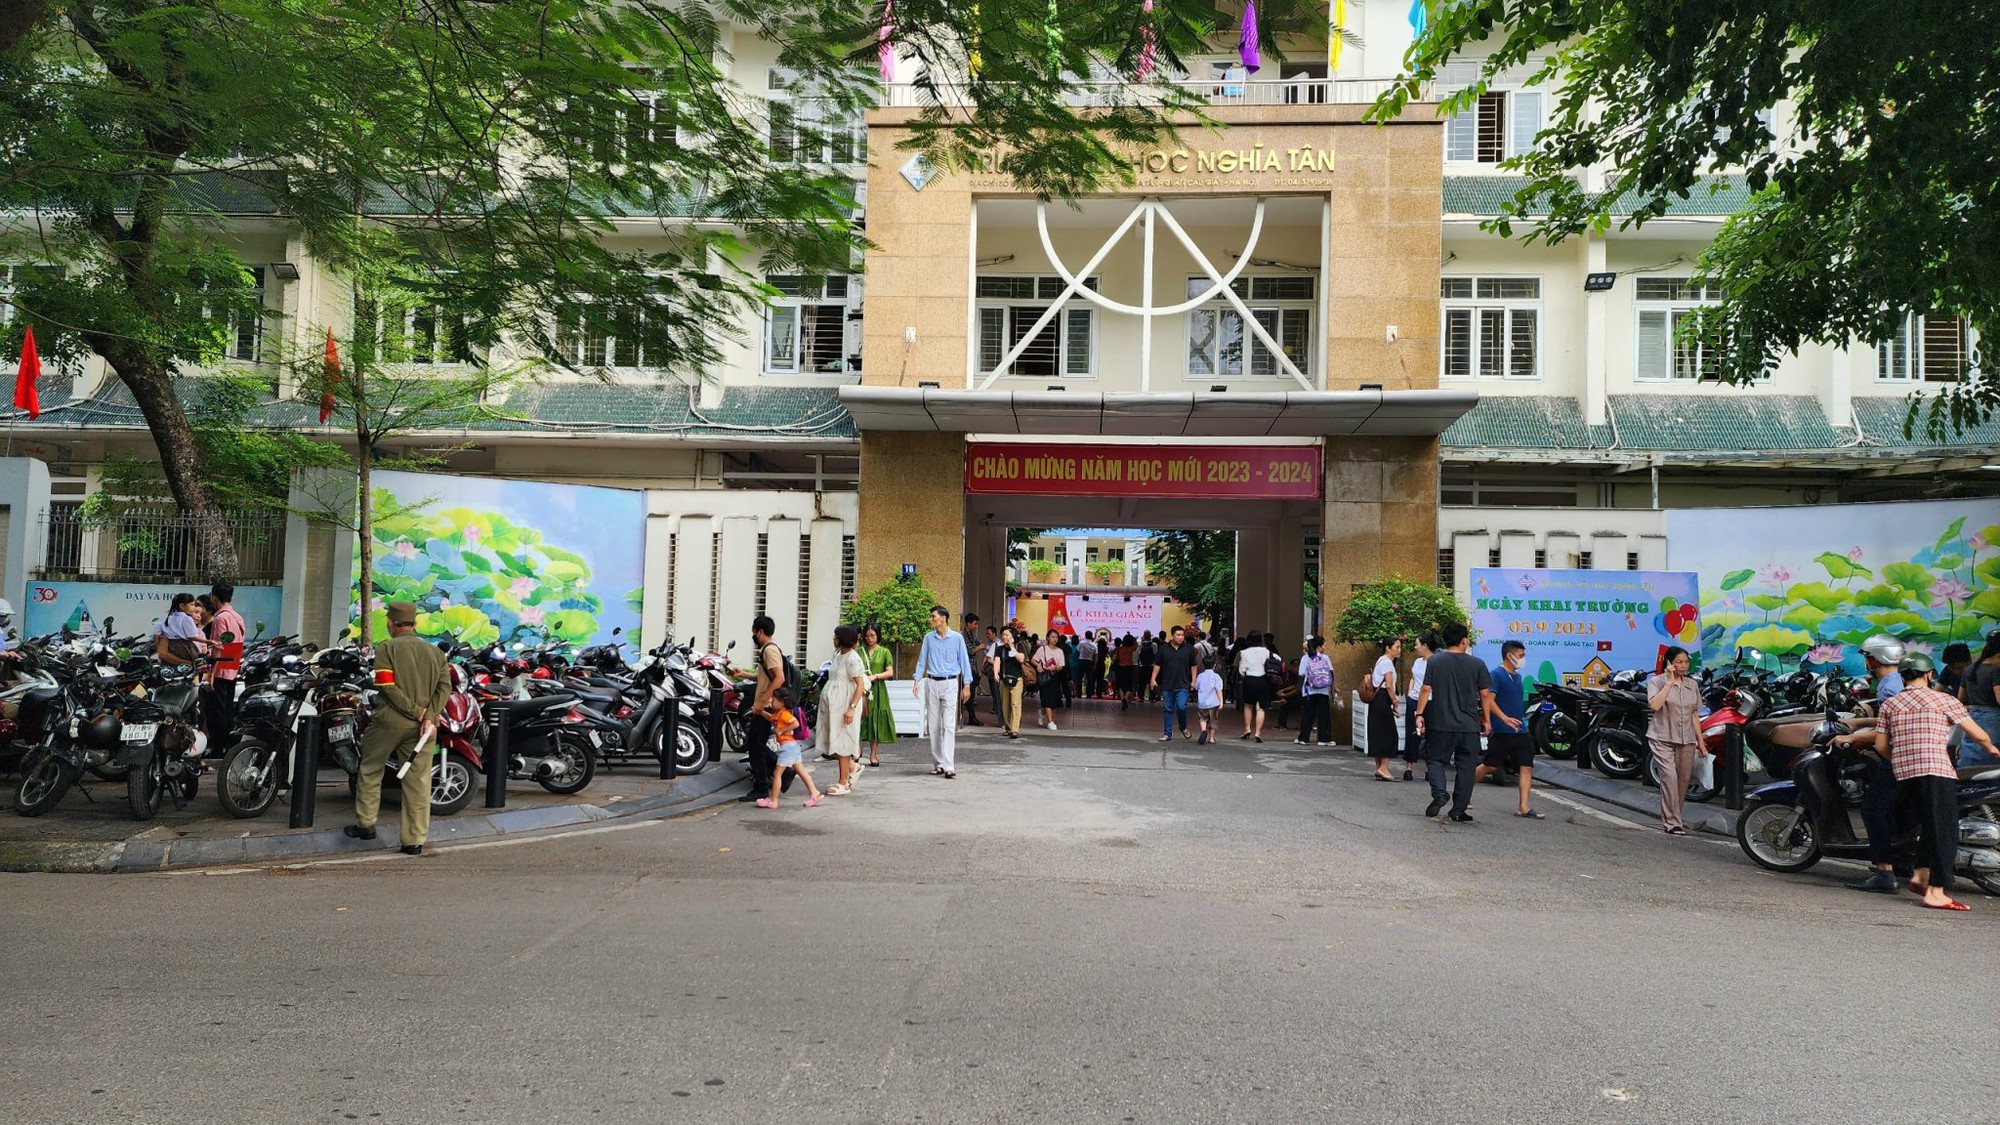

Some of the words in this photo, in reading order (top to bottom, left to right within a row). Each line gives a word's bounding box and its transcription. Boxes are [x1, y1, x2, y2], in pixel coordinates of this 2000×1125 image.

[1197, 142, 1282, 173] NGHĨA
[1288, 144, 1336, 172] TÂN
[973, 453, 1019, 479] CHÀO
[1024, 453, 1076, 480] MỪNG
[1081, 455, 1122, 481] NĂM
[1127, 460, 1162, 486] HỌC
[1168, 456, 1202, 482] MỚI
[1207, 461, 1250, 483] 2023
[1268, 461, 1312, 483] 2024
[904, 565, 914, 573] 16
[126, 592, 144, 602] DẠY
[147, 590, 161, 600] VÀ
[1476, 596, 1522, 611] NGÀY
[1528, 599, 1572, 612] KHAI
[1575, 598, 1649, 614] TRƯỜNG
[1069, 608, 1082, 618] LÊ
[1085, 610, 1113, 618] KHAI
[1115, 609, 1152, 619] GIẢNG
